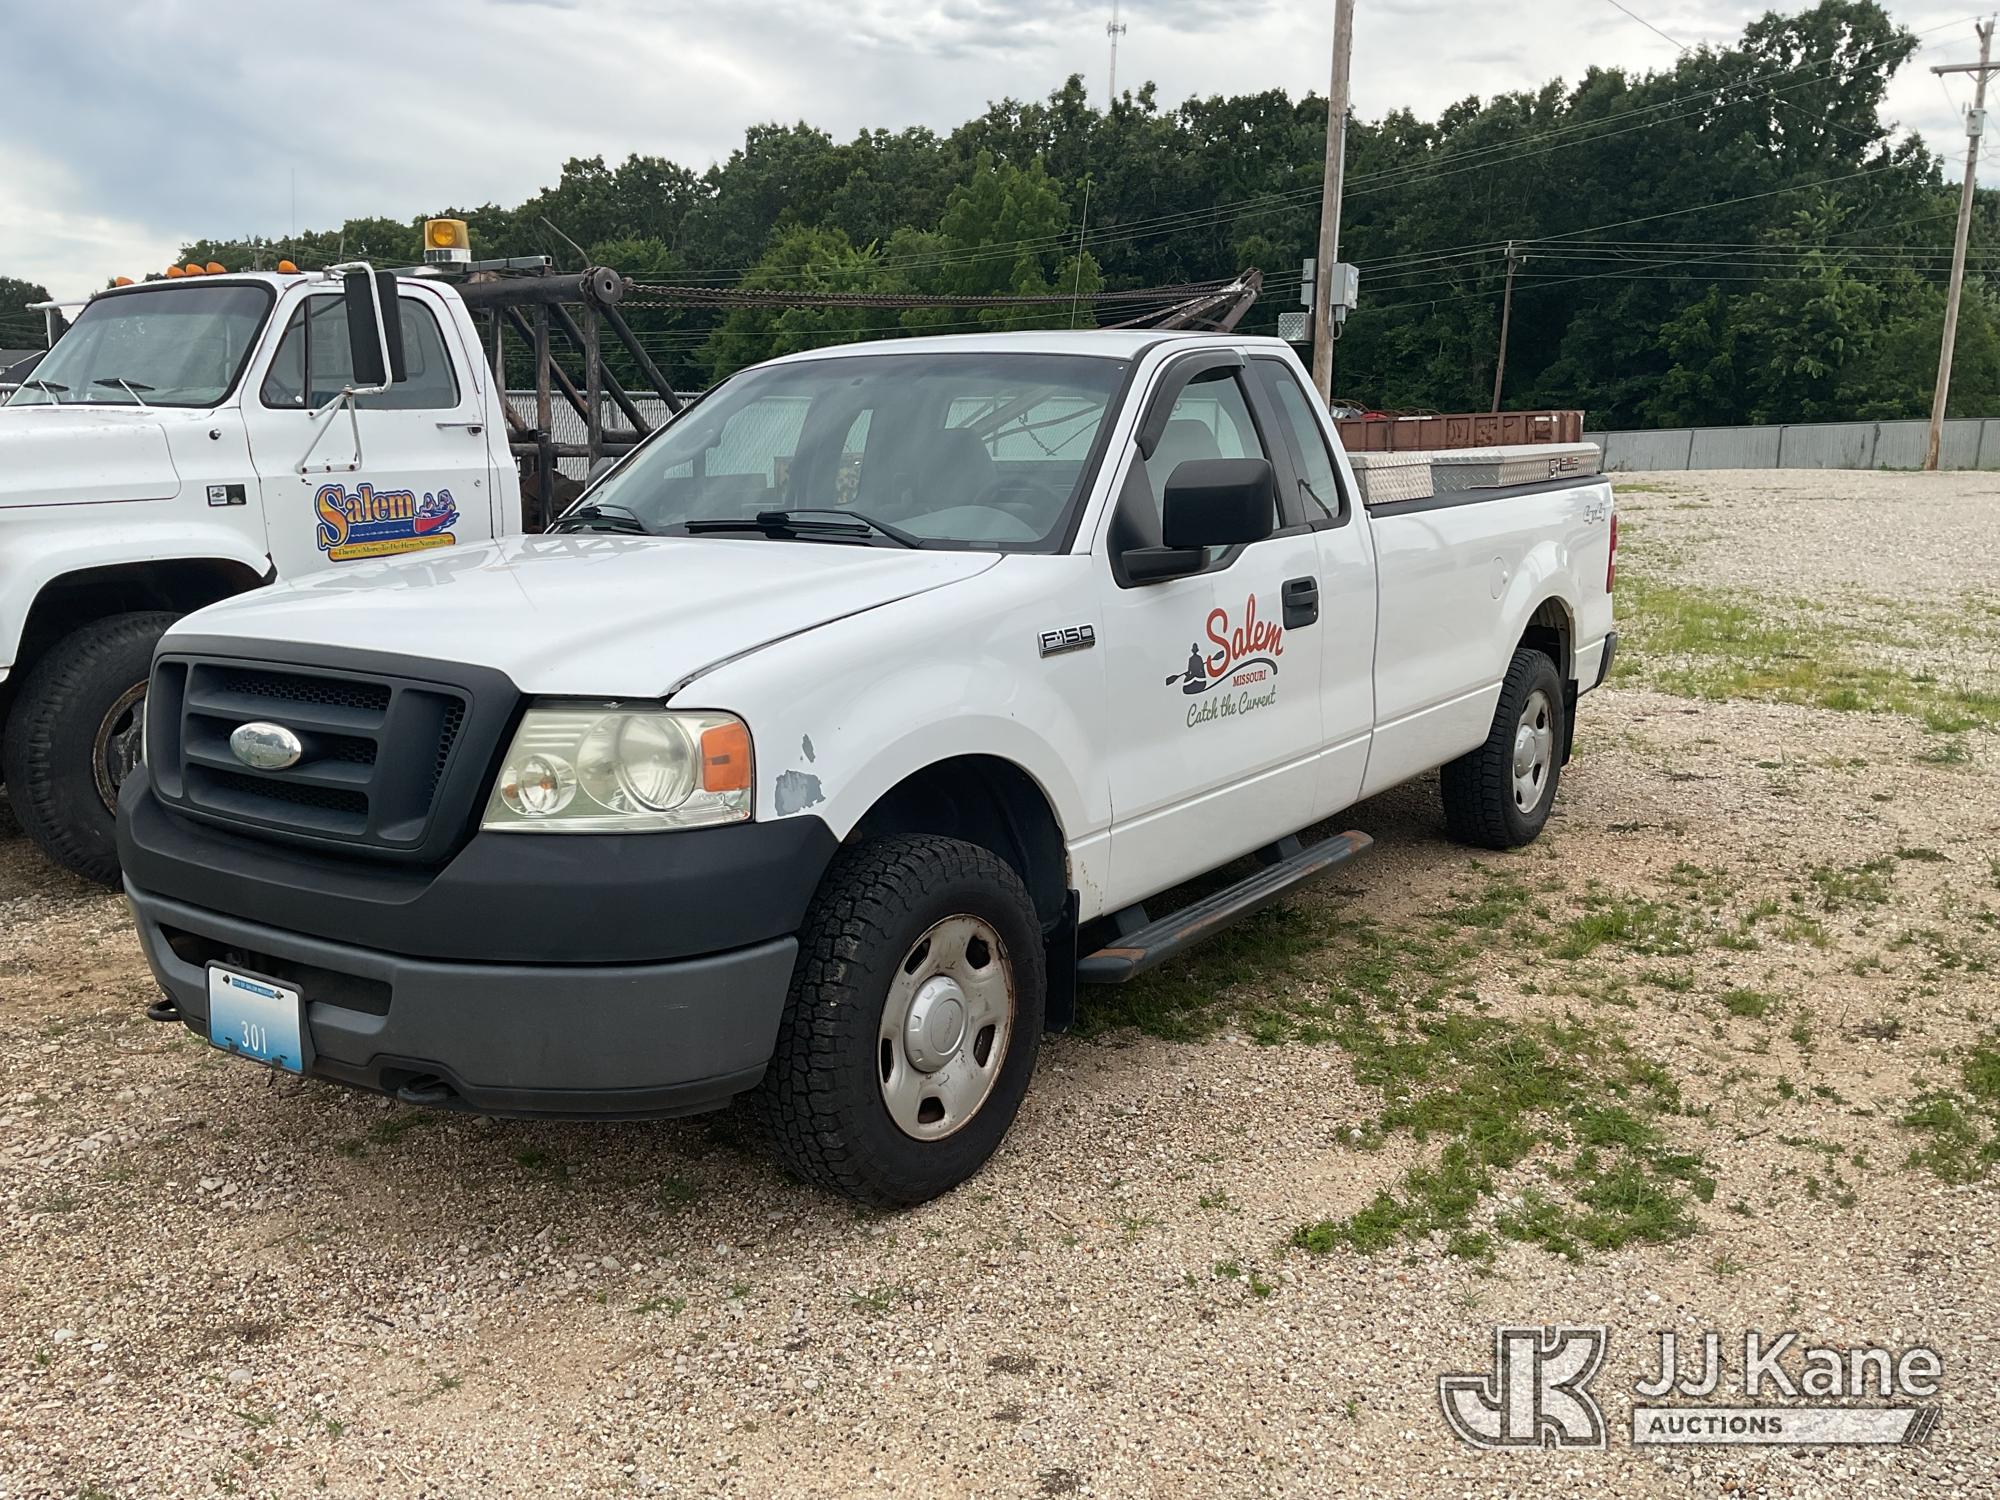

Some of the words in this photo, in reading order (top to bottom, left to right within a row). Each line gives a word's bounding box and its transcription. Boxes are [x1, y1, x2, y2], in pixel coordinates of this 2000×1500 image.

[315, 484, 416, 550] Salem
[1206, 593, 1283, 678] Salem
[1232, 669, 1267, 687] MISSOURI
[1186, 695, 1219, 728] Catch
[1220, 693, 1237, 718] the
[1238, 685, 1276, 716] Current
[241, 1020, 266, 1054] 301
